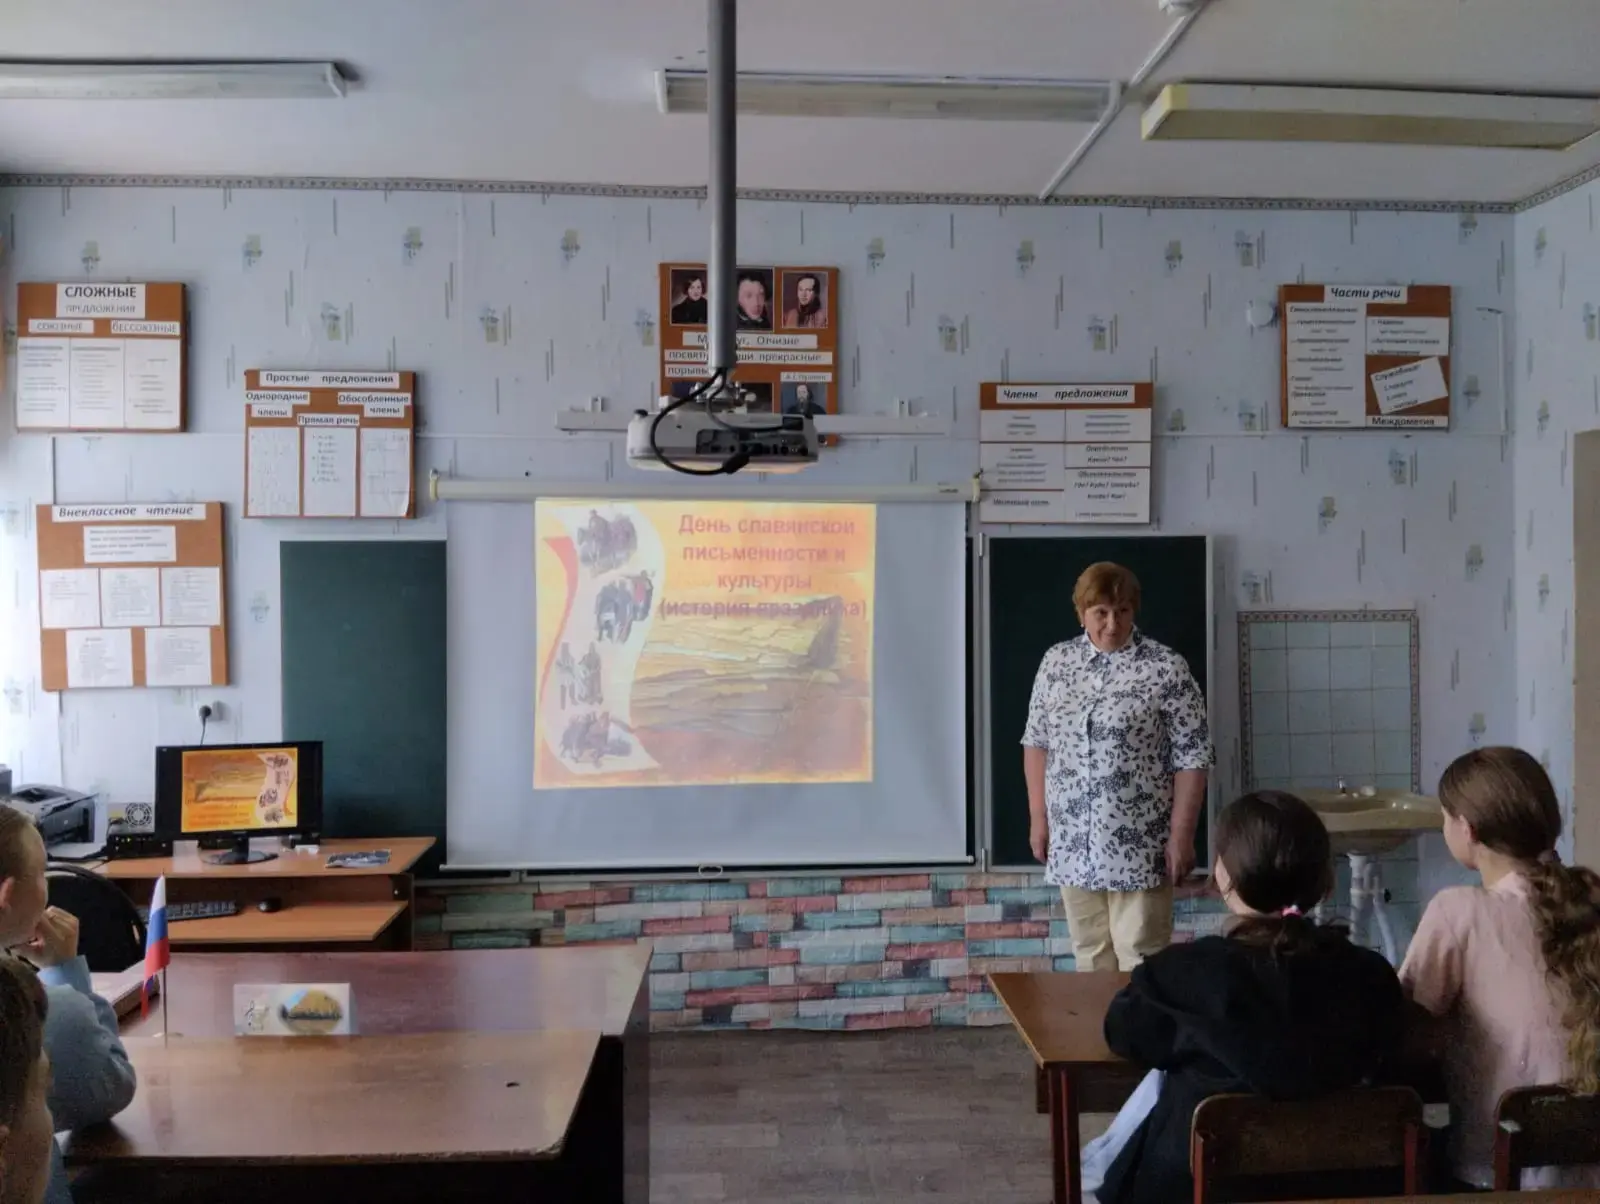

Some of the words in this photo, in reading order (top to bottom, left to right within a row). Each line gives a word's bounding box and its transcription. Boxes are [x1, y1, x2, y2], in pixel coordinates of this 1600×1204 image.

[64, 286, 137, 298] СЛОЖНЫЕ
[1330, 287, 1370, 298] Части
[1372, 287, 1401, 299] речи
[65, 304, 136, 314] ПРЕДЛОЖЕНИЯ
[756, 335, 800, 346] Отчизне
[759, 353, 823, 363] прекрасные
[265, 372, 310, 384] Простые
[321, 375, 394, 387] предложения
[246, 391, 308, 402] Однородные
[338, 393, 409, 403] Обособленные
[1003, 390, 1038, 399] Члены
[1054, 388, 1129, 400] предложения
[257, 408, 288, 416] члены
[369, 406, 401, 414] члены
[299, 415, 334, 425] Прямая
[336, 417, 358, 426] речь
[58, 507, 137, 517] Внеклассное
[146, 507, 193, 515] чтение
[678, 514, 732, 535] День
[682, 546, 829, 562] письменности
[834, 549, 846, 562] и
[717, 573, 813, 593] культуры
[659, 599, 750, 621] (история
